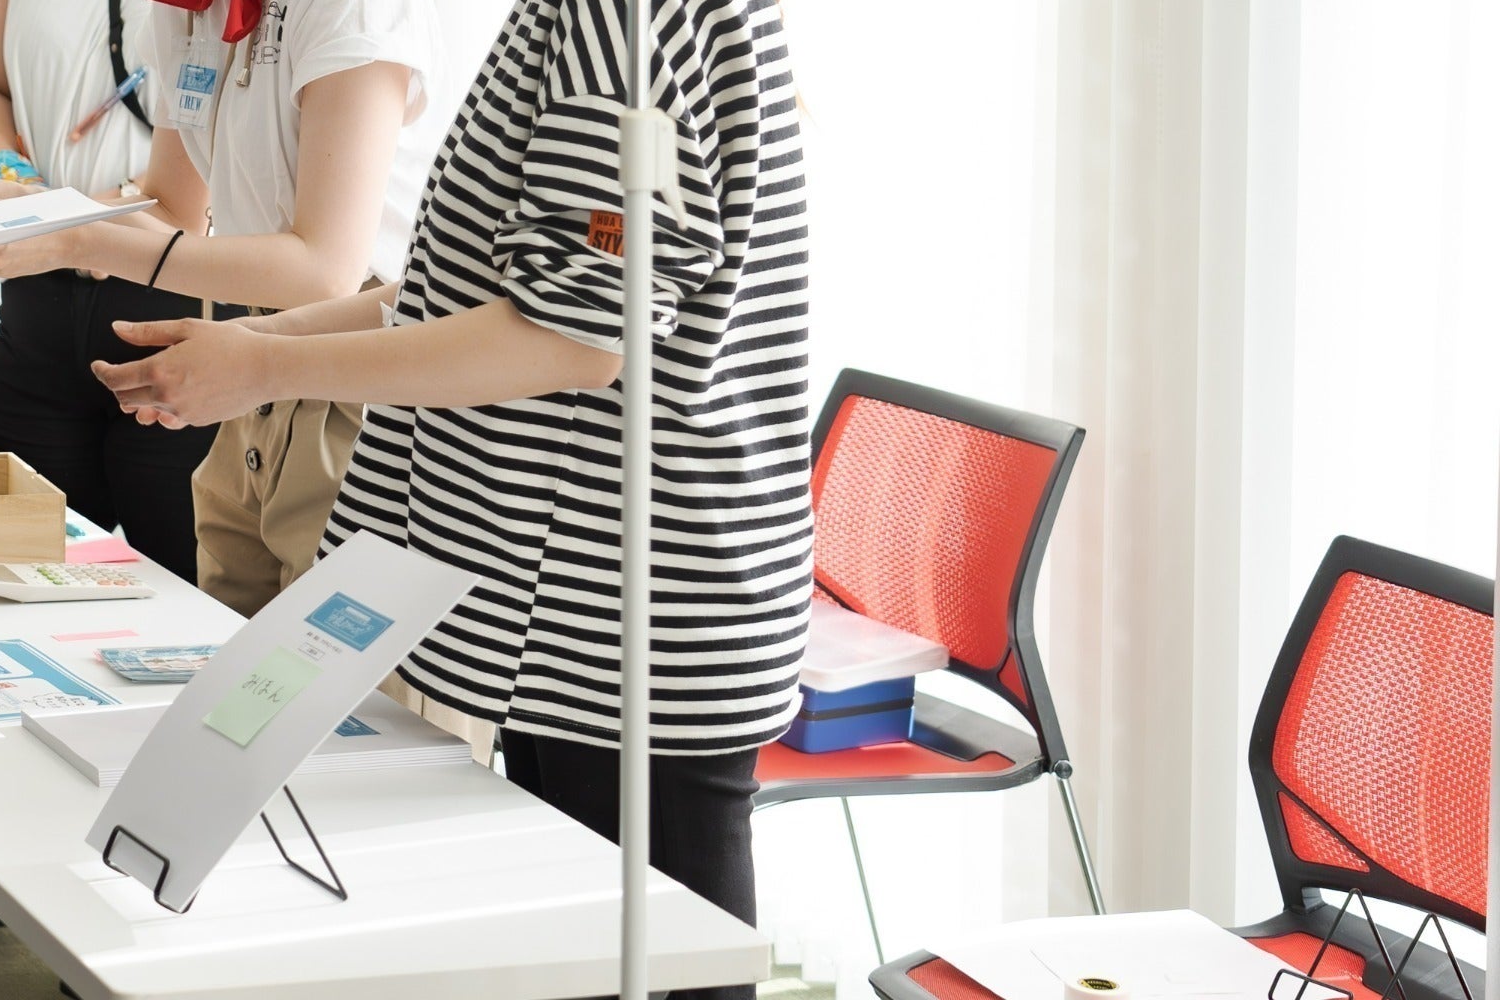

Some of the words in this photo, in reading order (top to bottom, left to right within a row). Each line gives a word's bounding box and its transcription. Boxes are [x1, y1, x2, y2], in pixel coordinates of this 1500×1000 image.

[179, 94, 203, 111] CREW
[241, 673, 285, 702] みほん
